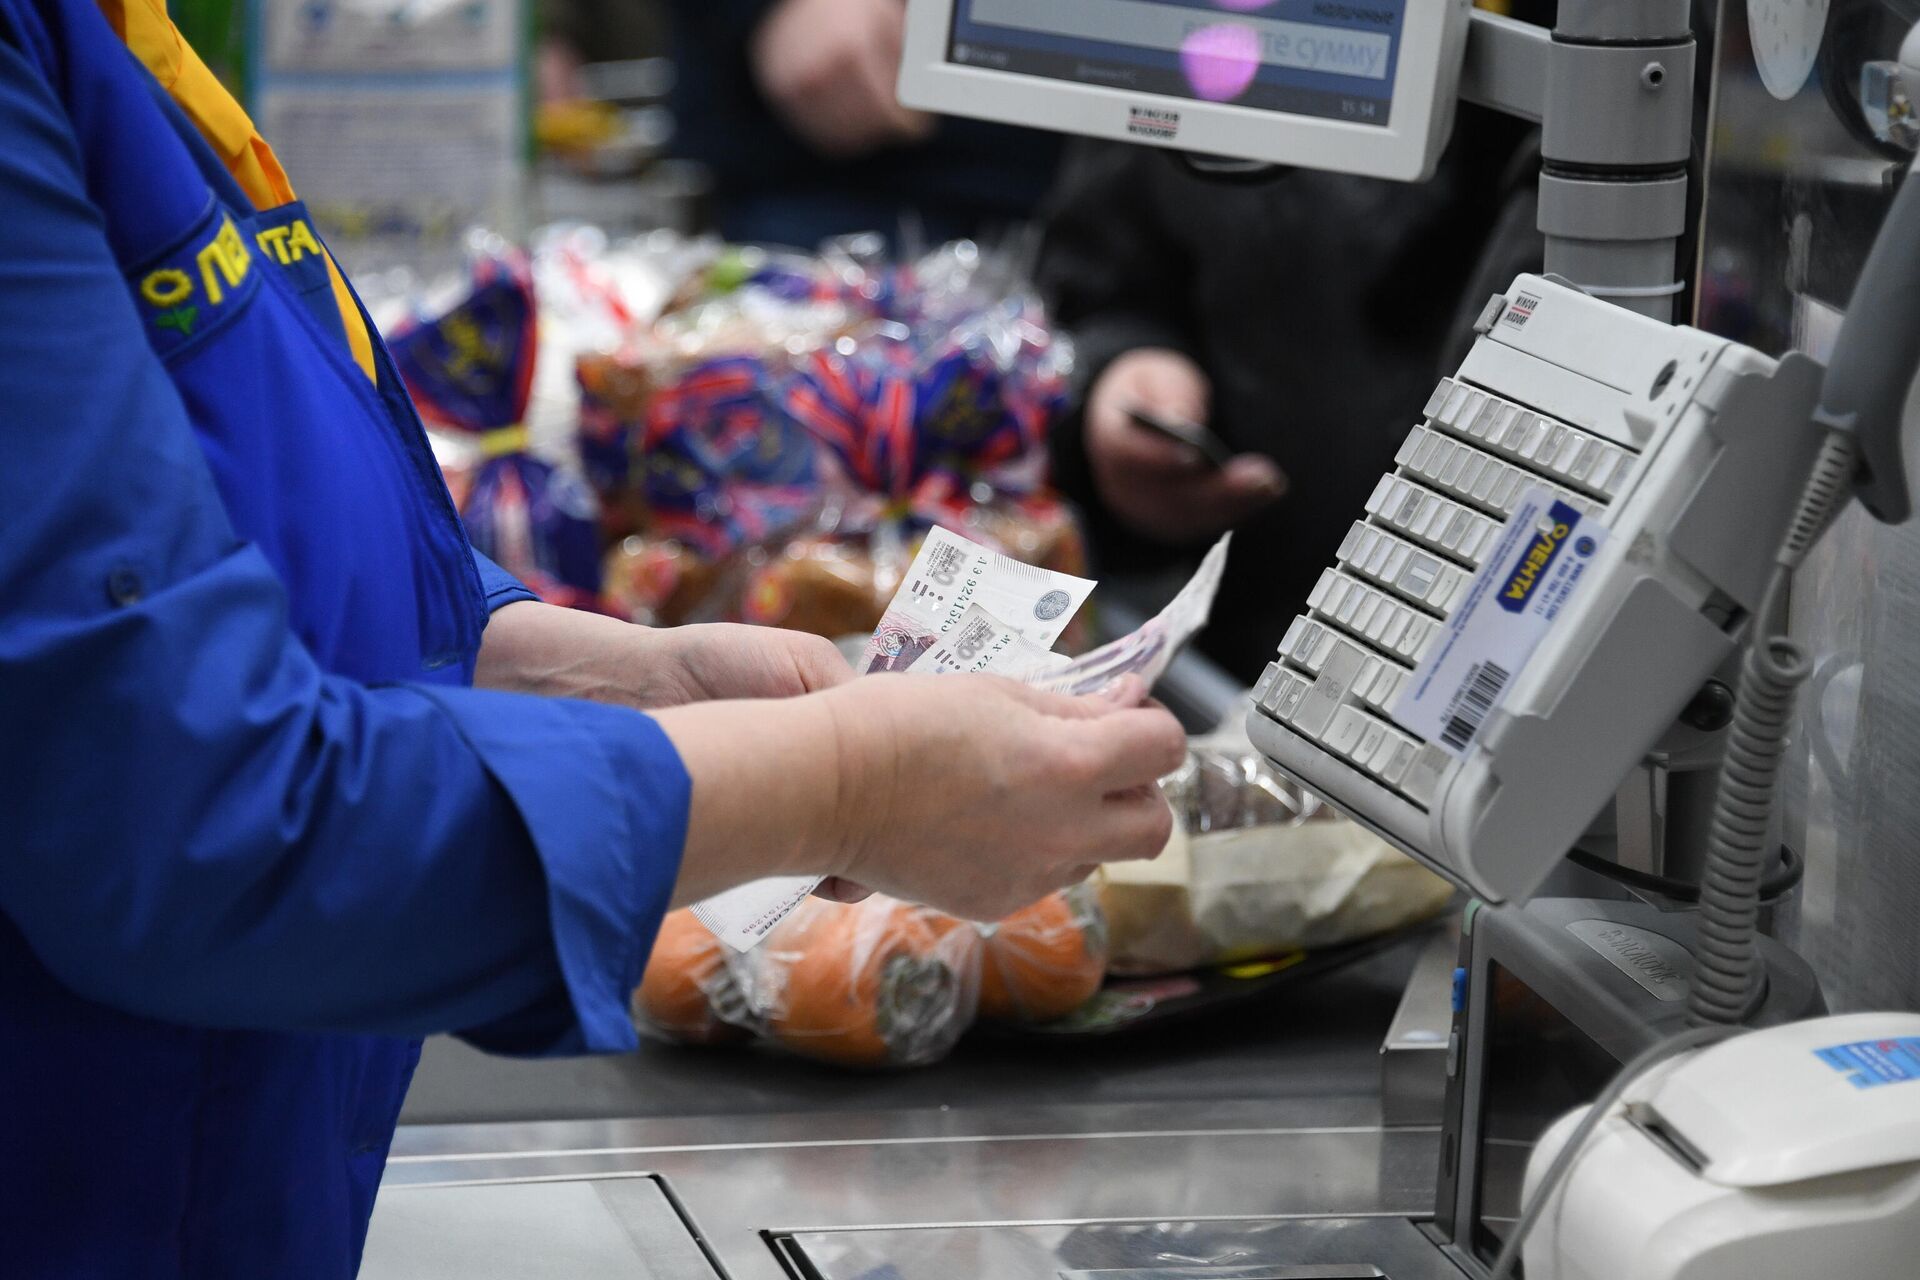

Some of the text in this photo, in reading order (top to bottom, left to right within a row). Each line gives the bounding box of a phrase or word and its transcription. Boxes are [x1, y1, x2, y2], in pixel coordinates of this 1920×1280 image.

[1297, 35, 1381, 67] сумму
[1515, 296, 1537, 310] WINCOR
[1504, 311, 1529, 326] NIXDORF
[1506, 533, 1556, 601] ЛЕНТА
